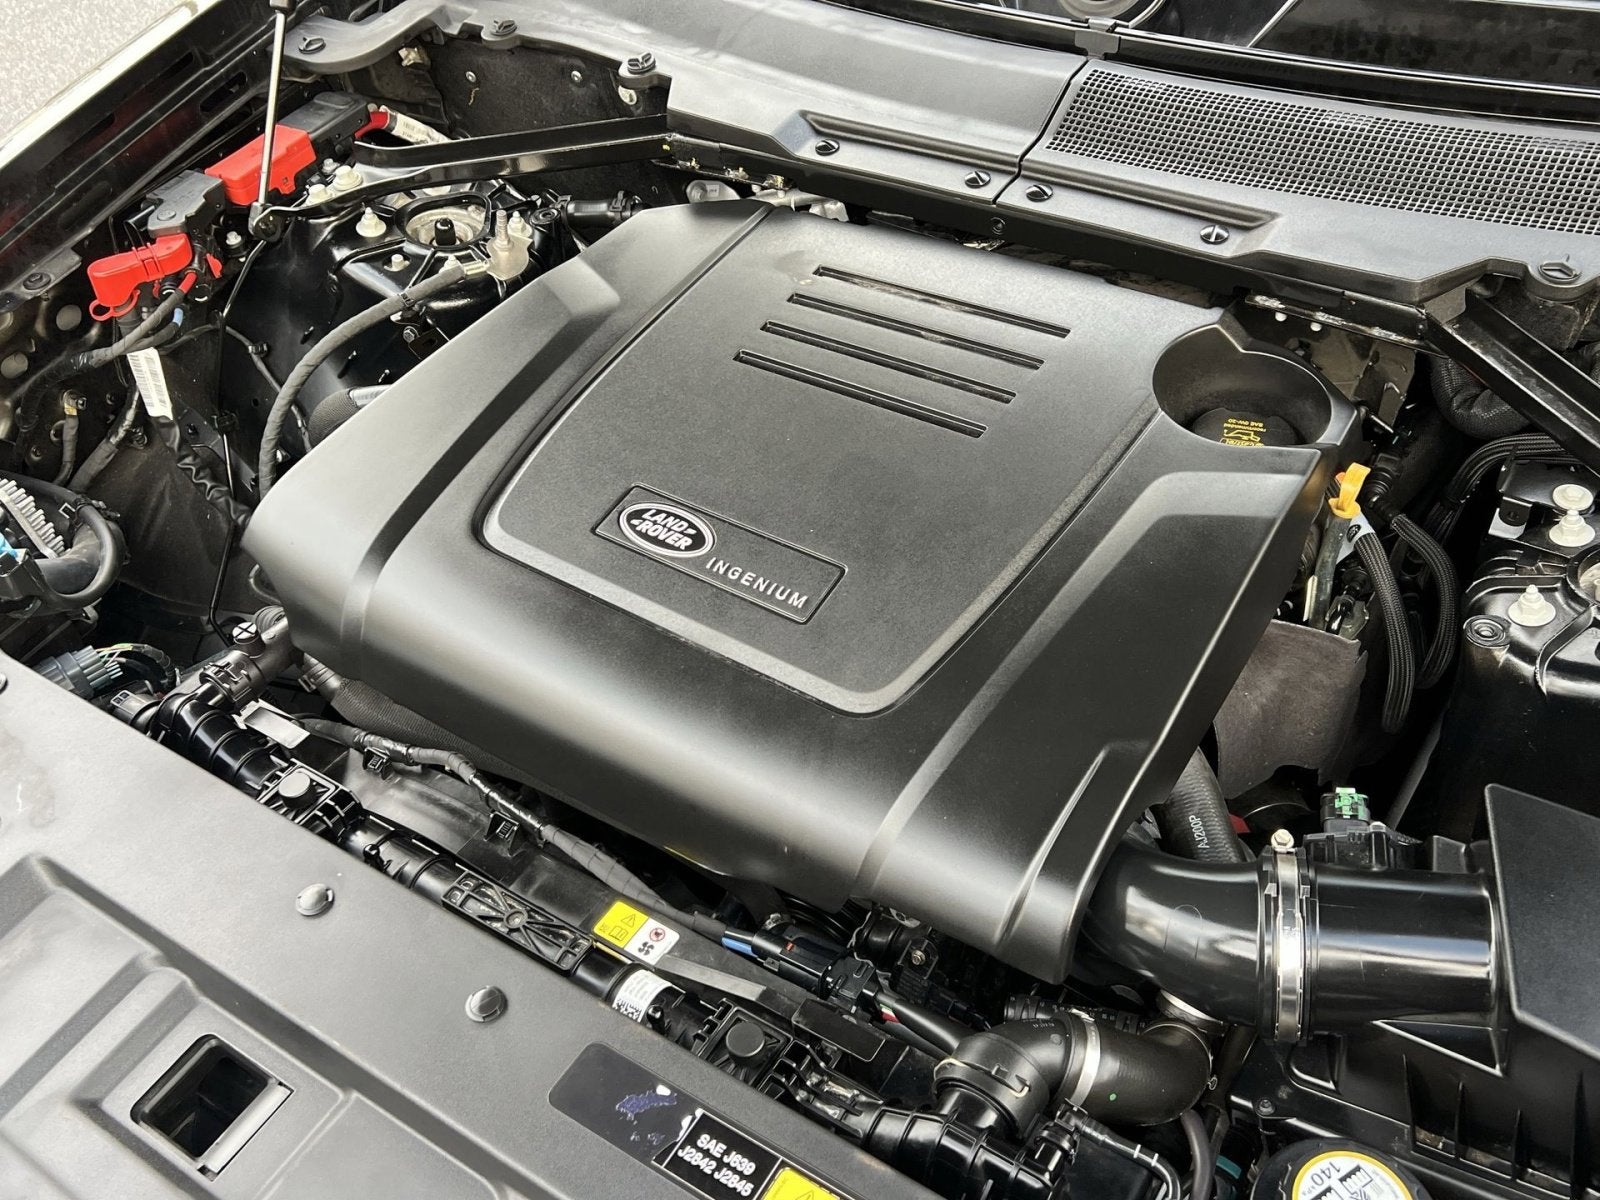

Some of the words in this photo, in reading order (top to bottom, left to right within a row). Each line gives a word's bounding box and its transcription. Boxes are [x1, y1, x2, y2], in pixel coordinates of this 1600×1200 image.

[635, 520, 693, 550] ROVER
[641, 509, 689, 532] LAND
[705, 557, 808, 609] INGENIUM
[1188, 814, 1210, 849] AJ200P
[677, 1145, 717, 1175] J2842
[713, 1167, 755, 1197] J2845
[696, 1133, 728, 1158] SAE
[722, 1150, 756, 1176] J639
[1310, 1161, 1341, 1187] 140
